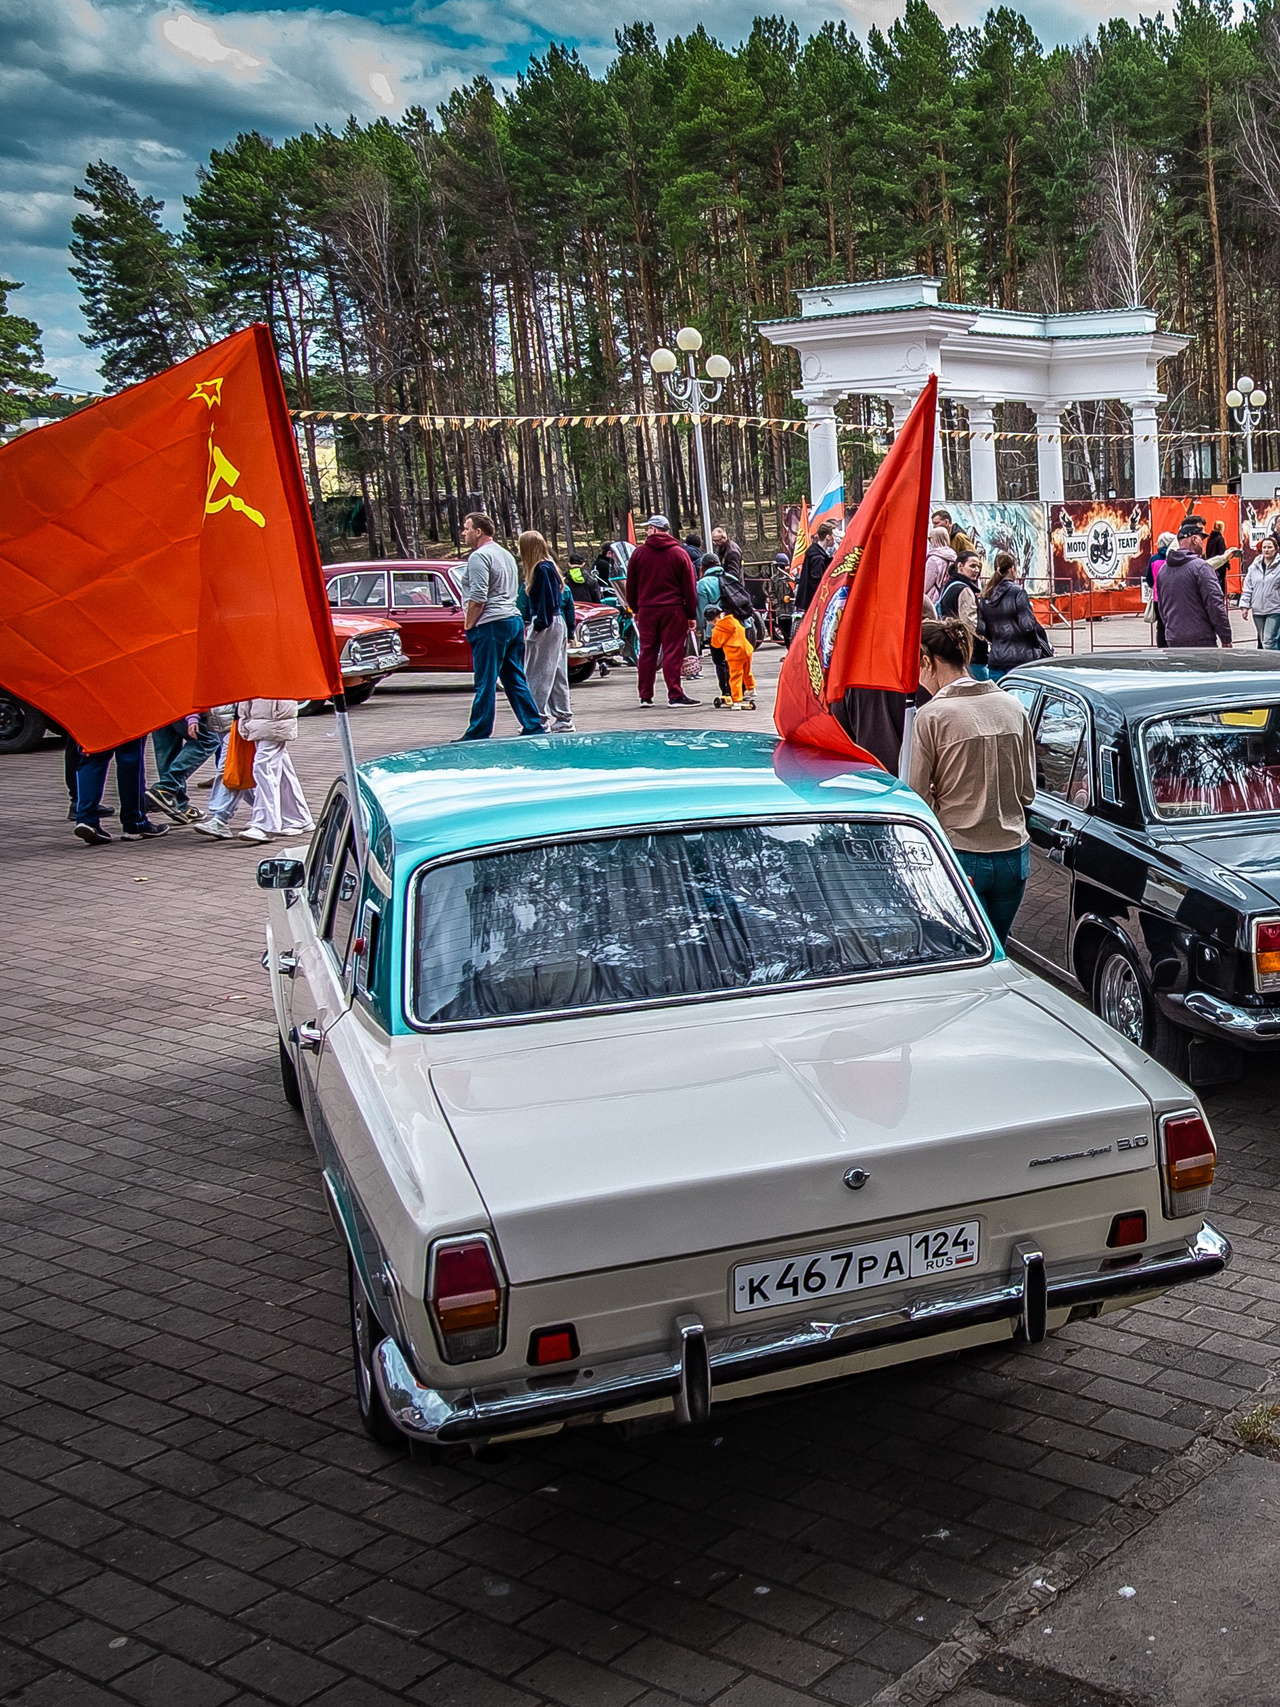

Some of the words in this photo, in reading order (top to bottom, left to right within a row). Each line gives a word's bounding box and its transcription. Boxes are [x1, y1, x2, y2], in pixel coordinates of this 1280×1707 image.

[1252, 532, 1266, 541] МОТО
[1067, 541, 1087, 553] МОТО
[1118, 537, 1138, 549] ТЕАТР
[748, 1250, 906, 1305] К467РА
[914, 1226, 969, 1261] 124
[926, 1256, 954, 1271] RUS
